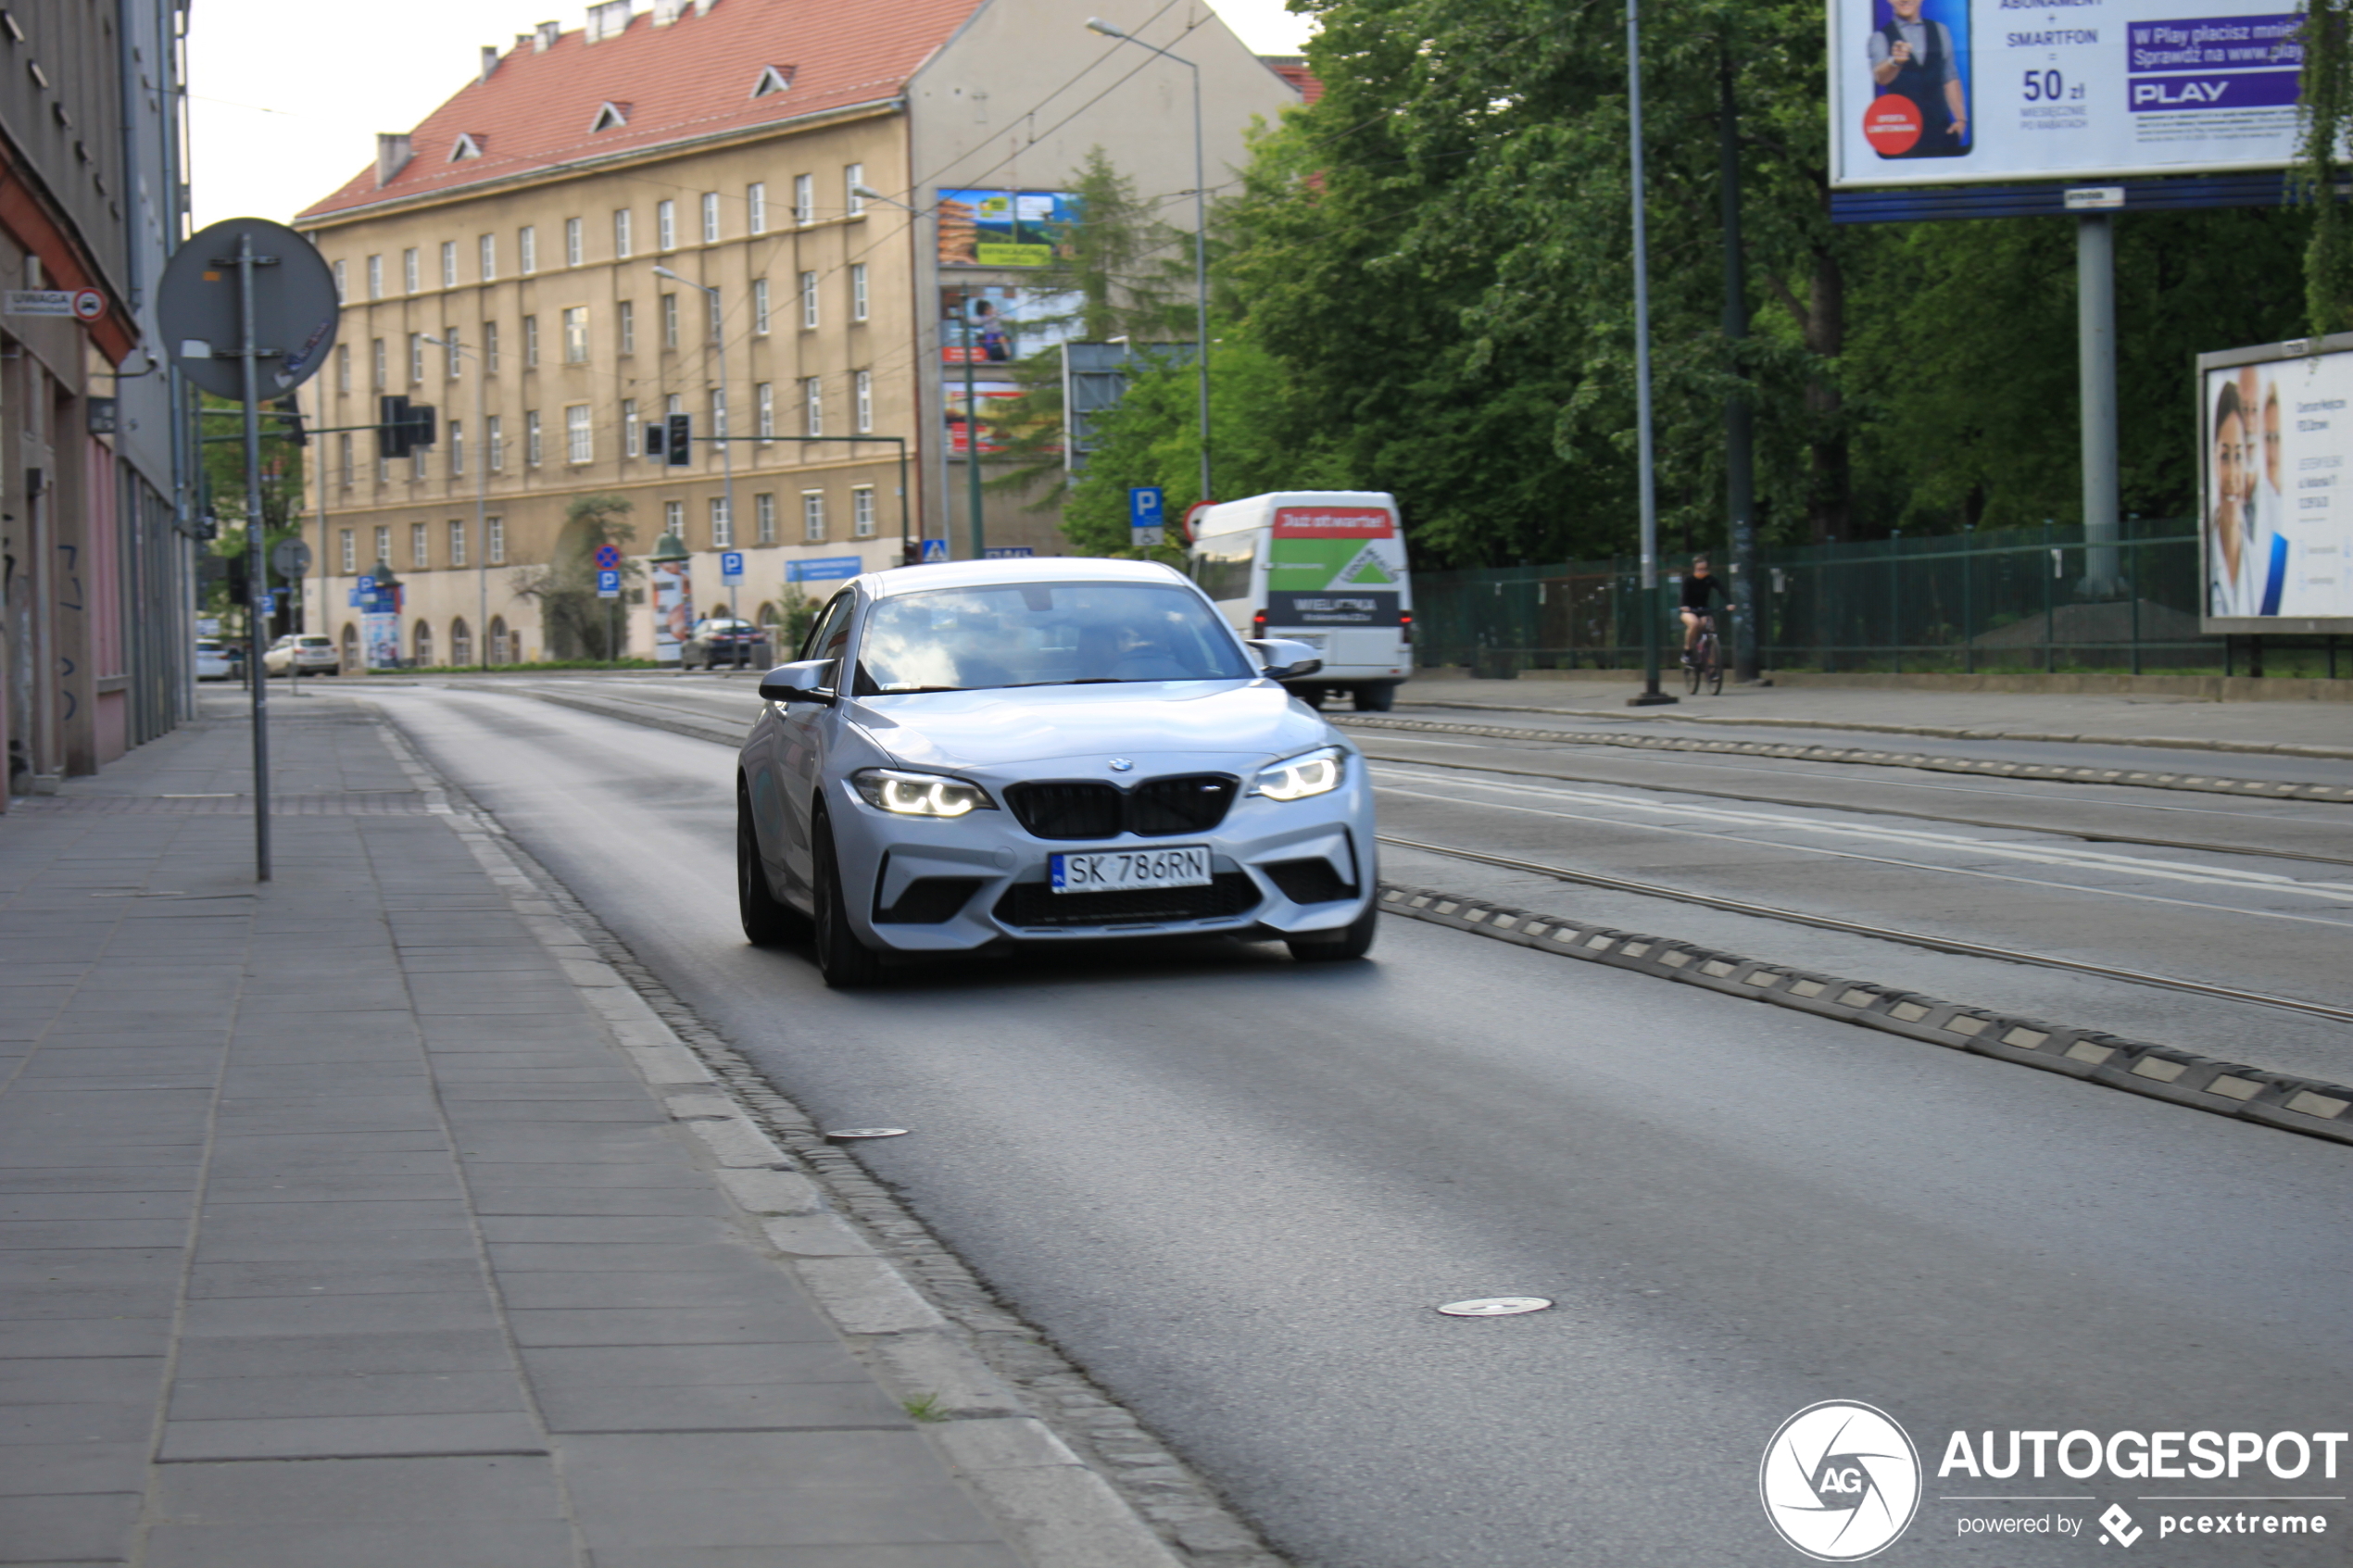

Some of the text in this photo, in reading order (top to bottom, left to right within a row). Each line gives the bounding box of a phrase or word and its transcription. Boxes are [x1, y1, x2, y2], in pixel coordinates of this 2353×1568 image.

[2007, 29, 2098, 47] SMARTFON
[2133, 29, 2151, 44] W
[2154, 26, 2189, 46] Play
[2192, 24, 2250, 46] płacisz
[2133, 46, 2202, 69] Sprawdź
[2205, 49, 2225, 62] na
[2023, 69, 2062, 101] 50
[2134, 82, 2230, 105] PLAY
[12, 293, 69, 304] UWAGA
[1070, 849, 1204, 884] SK 786RN
